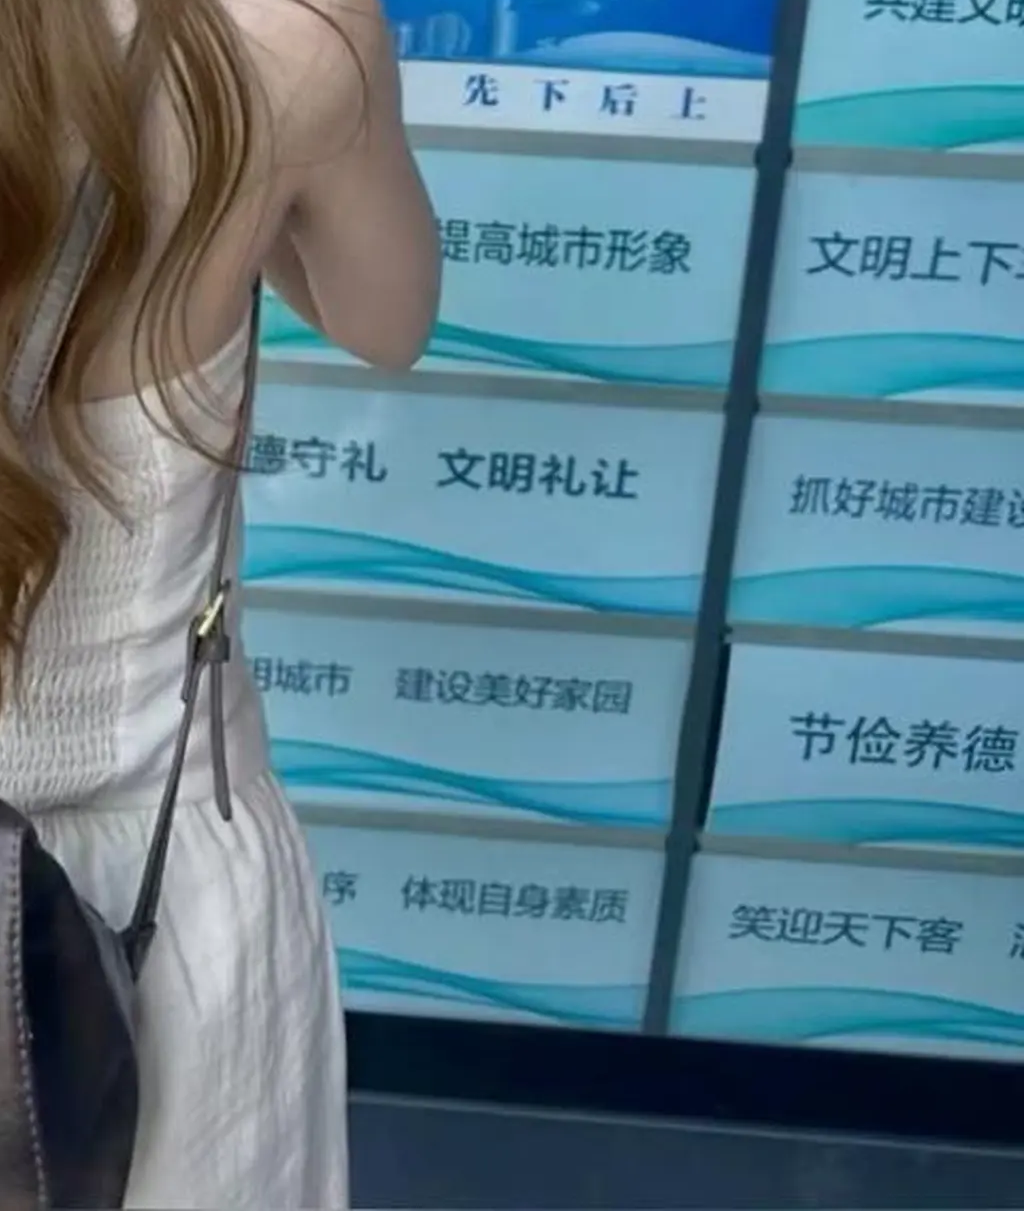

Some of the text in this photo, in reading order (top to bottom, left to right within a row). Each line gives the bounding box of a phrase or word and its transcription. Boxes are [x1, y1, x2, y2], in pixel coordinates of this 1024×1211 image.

[464, 74, 707, 121] 先下后上
[436, 217, 691, 276] 提高城市形象
[806, 231, 1024, 286] 文明上下
[436, 446, 638, 499] 文明礼让
[395, 667, 633, 715] 建设美好家园
[790, 712, 1018, 775] 节俭养德
[401, 875, 629, 923] 体现自身素质
[729, 903, 964, 955] 笑迎天下客
